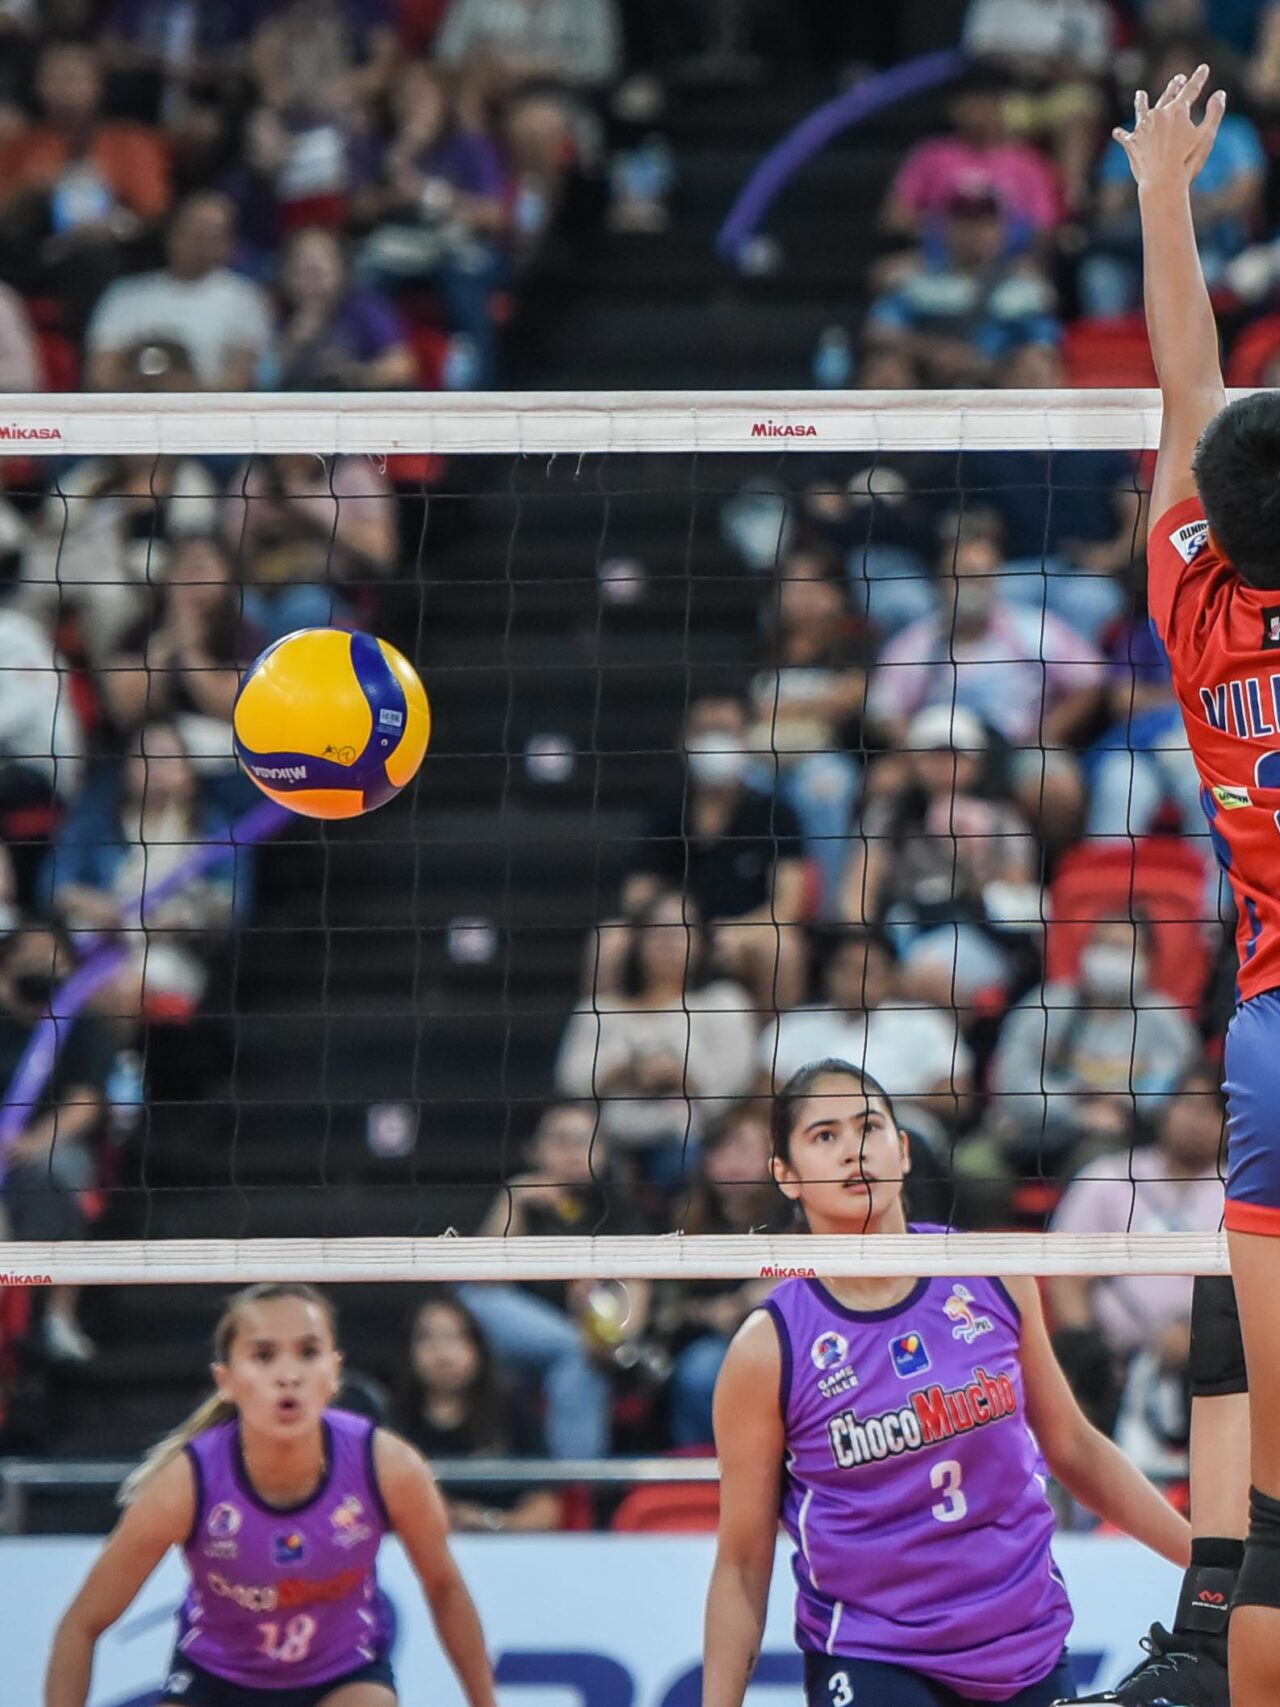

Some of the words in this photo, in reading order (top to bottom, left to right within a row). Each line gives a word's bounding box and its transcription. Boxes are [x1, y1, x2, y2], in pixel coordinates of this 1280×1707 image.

[817, 1364, 854, 1391] GAME
[821, 1375, 859, 1399] VILLE
[929, 1460, 968, 1522] 3
[255, 1613, 316, 1664] 18
[828, 1671, 854, 1707] 3
